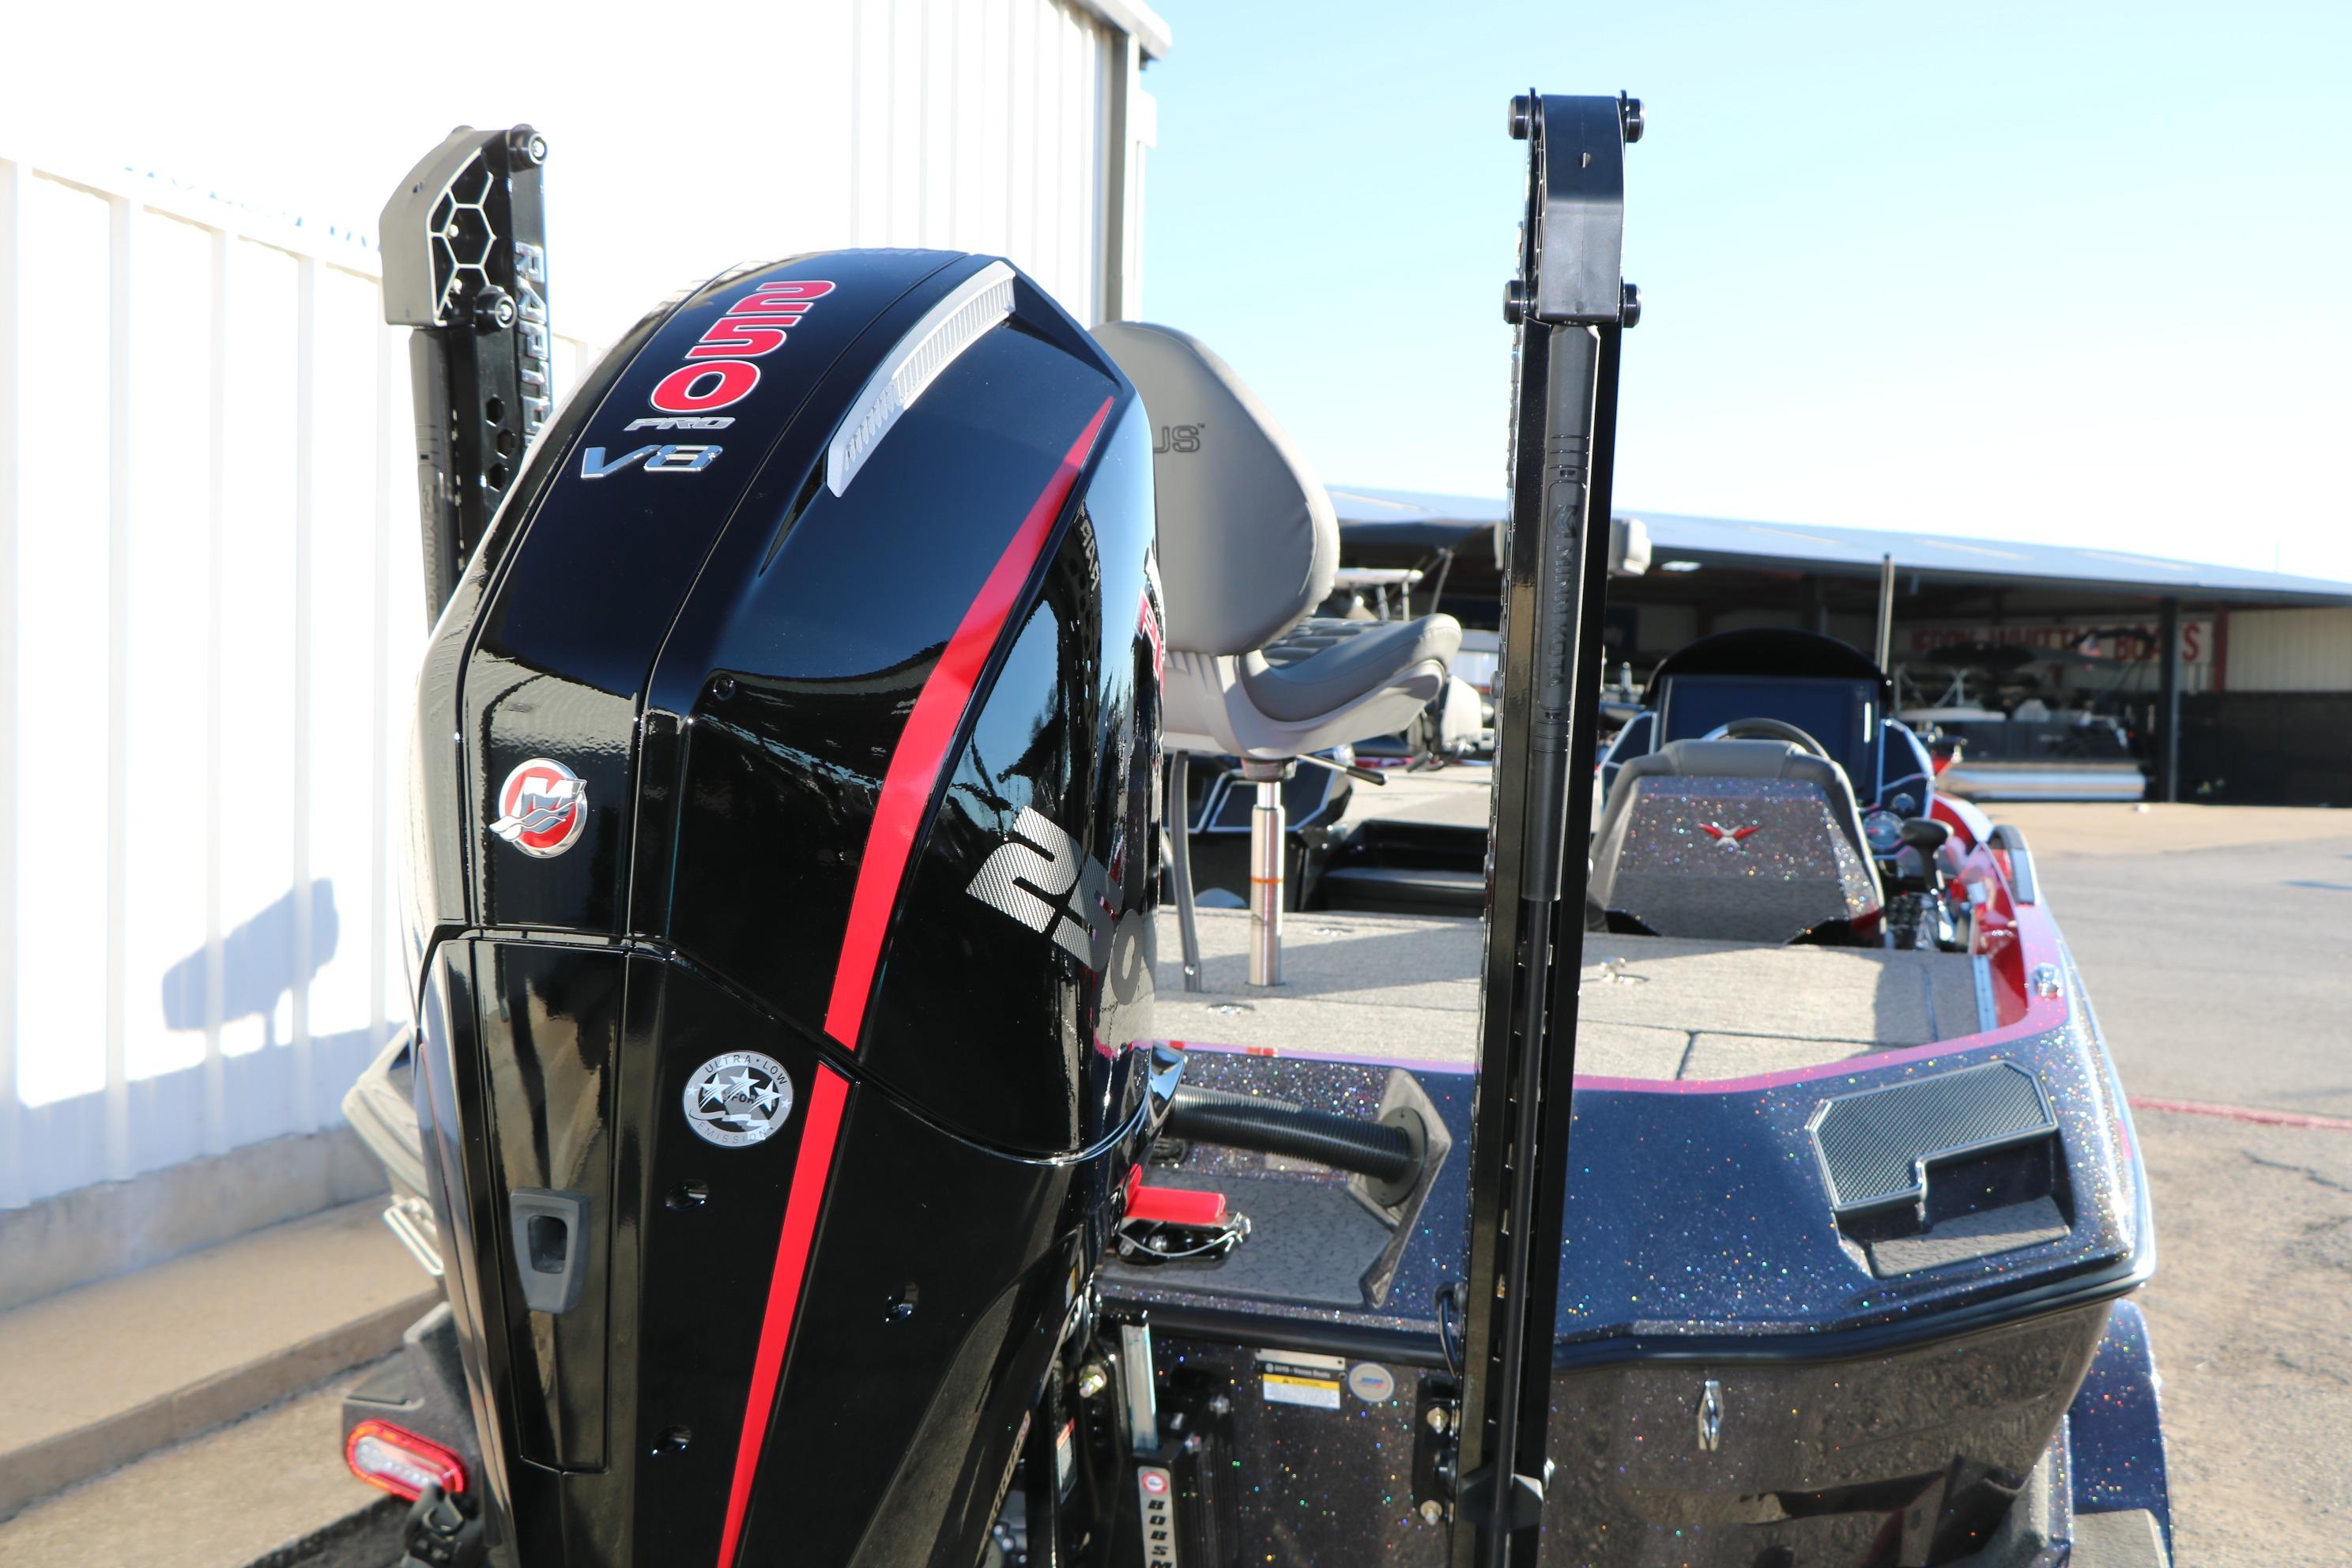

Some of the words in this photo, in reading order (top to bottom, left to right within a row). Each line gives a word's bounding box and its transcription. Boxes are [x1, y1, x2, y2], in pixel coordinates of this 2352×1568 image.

[650, 280, 836, 413] 250
[624, 416, 736, 432] PRO
[581, 444, 724, 480] V8
[1555, 544, 1572, 614] MINN
[966, 805, 1144, 1006] 250
[704, 1054, 752, 1073] ULTRA
[763, 1061, 788, 1085] LOW
[698, 1121, 767, 1144] EMISSION
